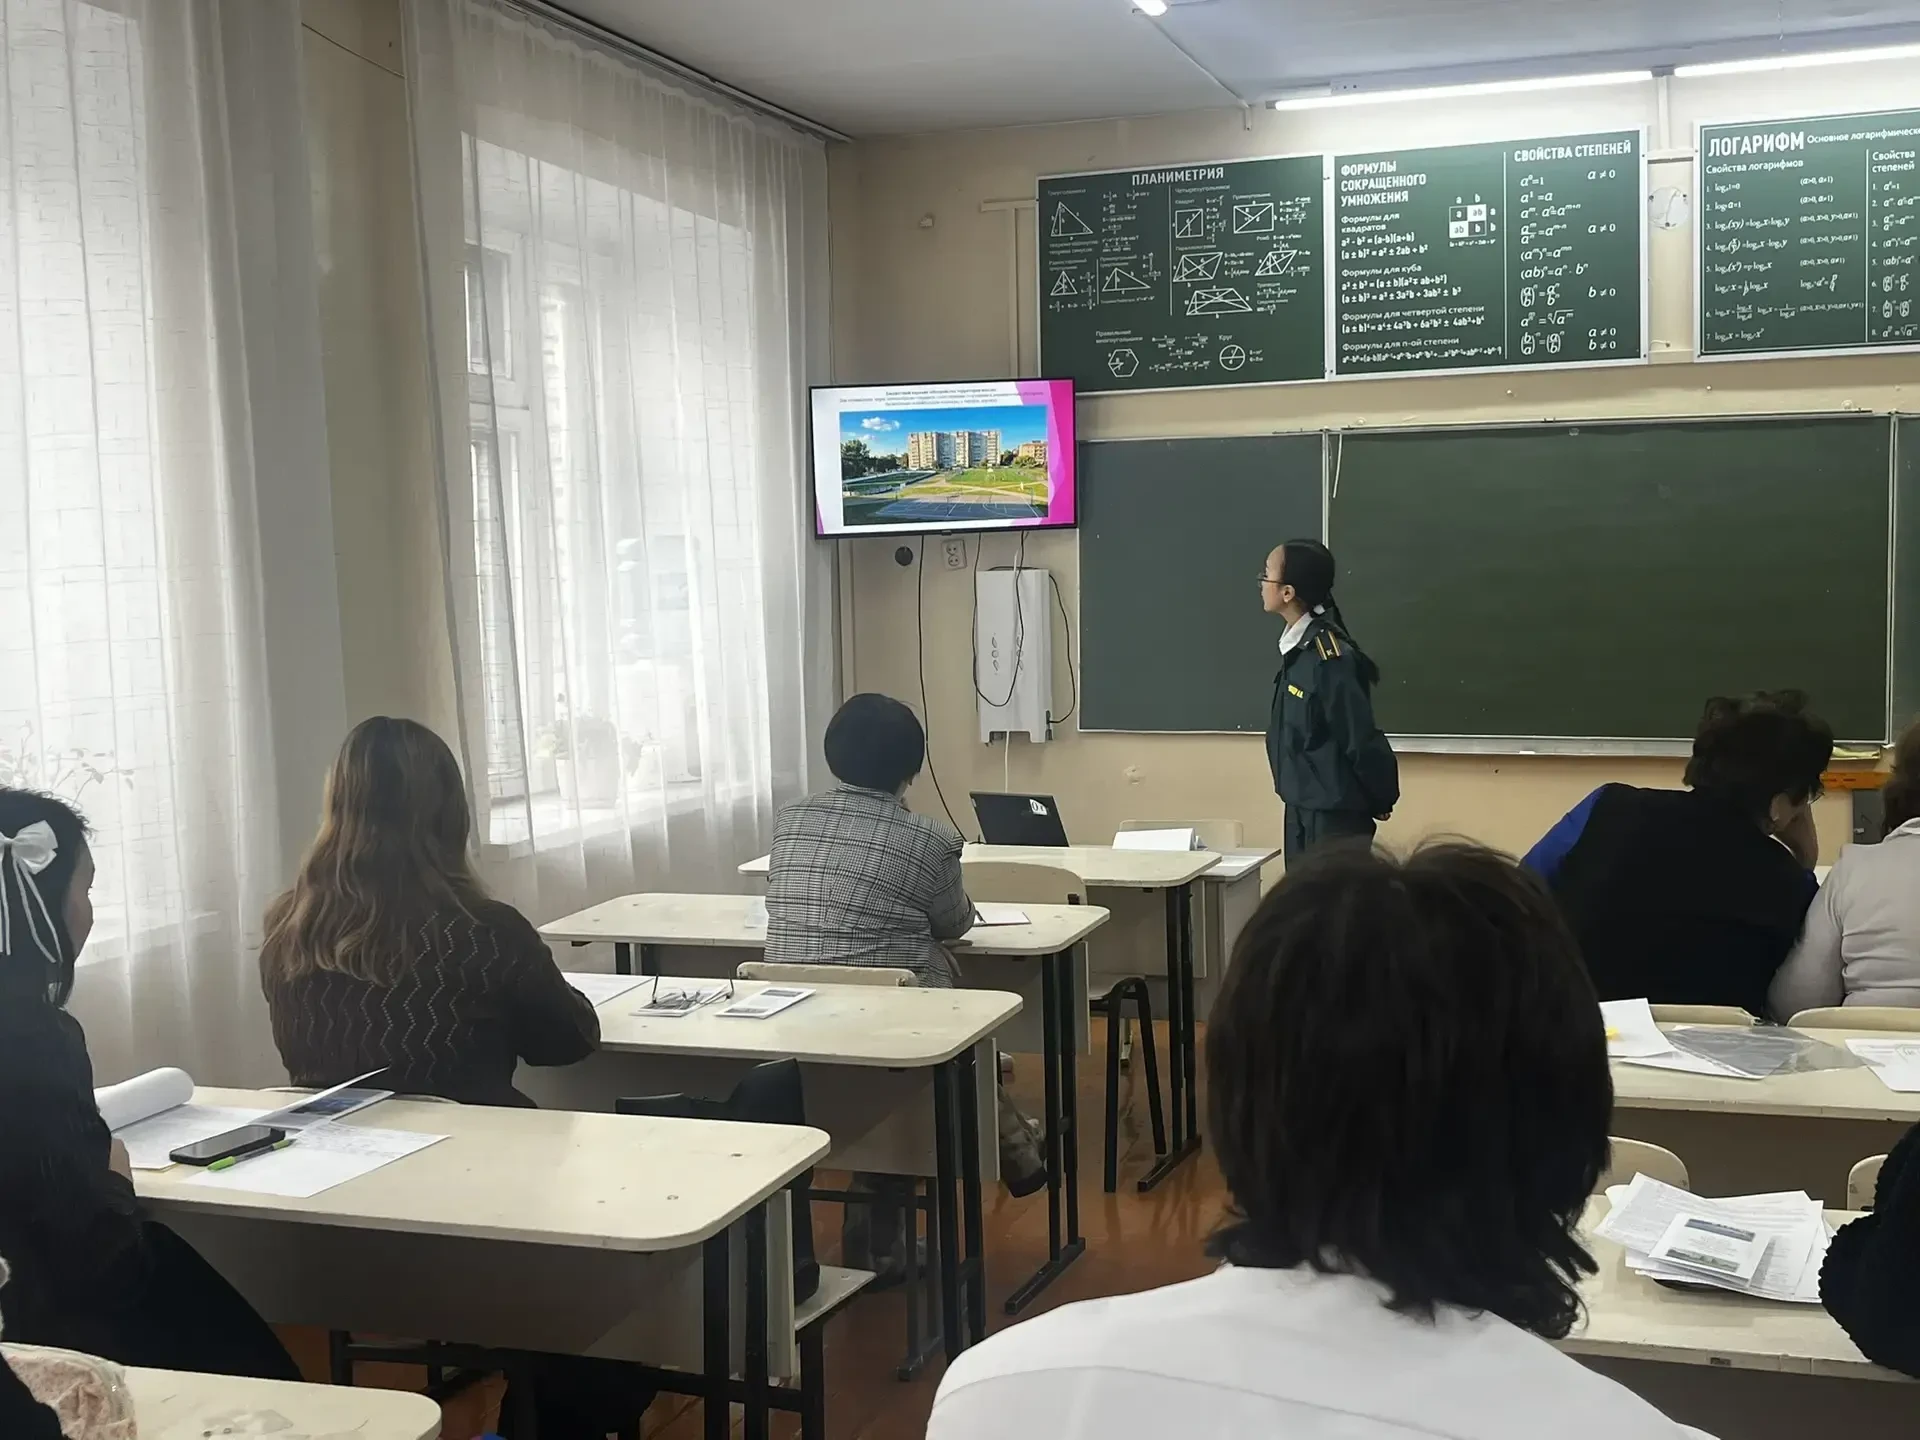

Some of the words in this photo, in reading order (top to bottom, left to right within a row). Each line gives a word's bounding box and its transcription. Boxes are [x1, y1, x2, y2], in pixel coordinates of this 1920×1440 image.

[1708, 131, 1804, 157] ЛОГАРИФМ
[1807, 134, 1849, 144] Основное
[1514, 147, 1573, 162] СВОЙСТВА
[1575, 140, 1631, 157] СТЕПЕНЕЙ
[1872, 150, 1916, 160] Свойства
[1340, 160, 1397, 176] ФОРМУЛЫ
[1706, 163, 1746, 174] Свойства
[1748, 160, 1804, 172] логарифмов
[1872, 160, 1915, 173] степеней
[1132, 167, 1225, 187] ПЛАНИМЕТРИЯ
[1340, 174, 1427, 192] СОКРАЩЕННОГО
[1340, 190, 1409, 207] УМНОЖЕНИЯ
[1341, 215, 1382, 224] Формулы
[1383, 213, 1400, 222] для
[1341, 224, 1386, 234] квадратов
[1342, 268, 1382, 278] Формулы
[1384, 266, 1400, 275] для
[1402, 264, 1422, 274] куба
[1342, 313, 1382, 322] Формулы
[1384, 310, 1400, 319] для
[1402, 307, 1446, 318] четвертой
[1448, 306, 1484, 314] степени
[1342, 342, 1382, 351] Формулы
[1384, 341, 1400, 350] для
[1424, 338, 1459, 346] степени
